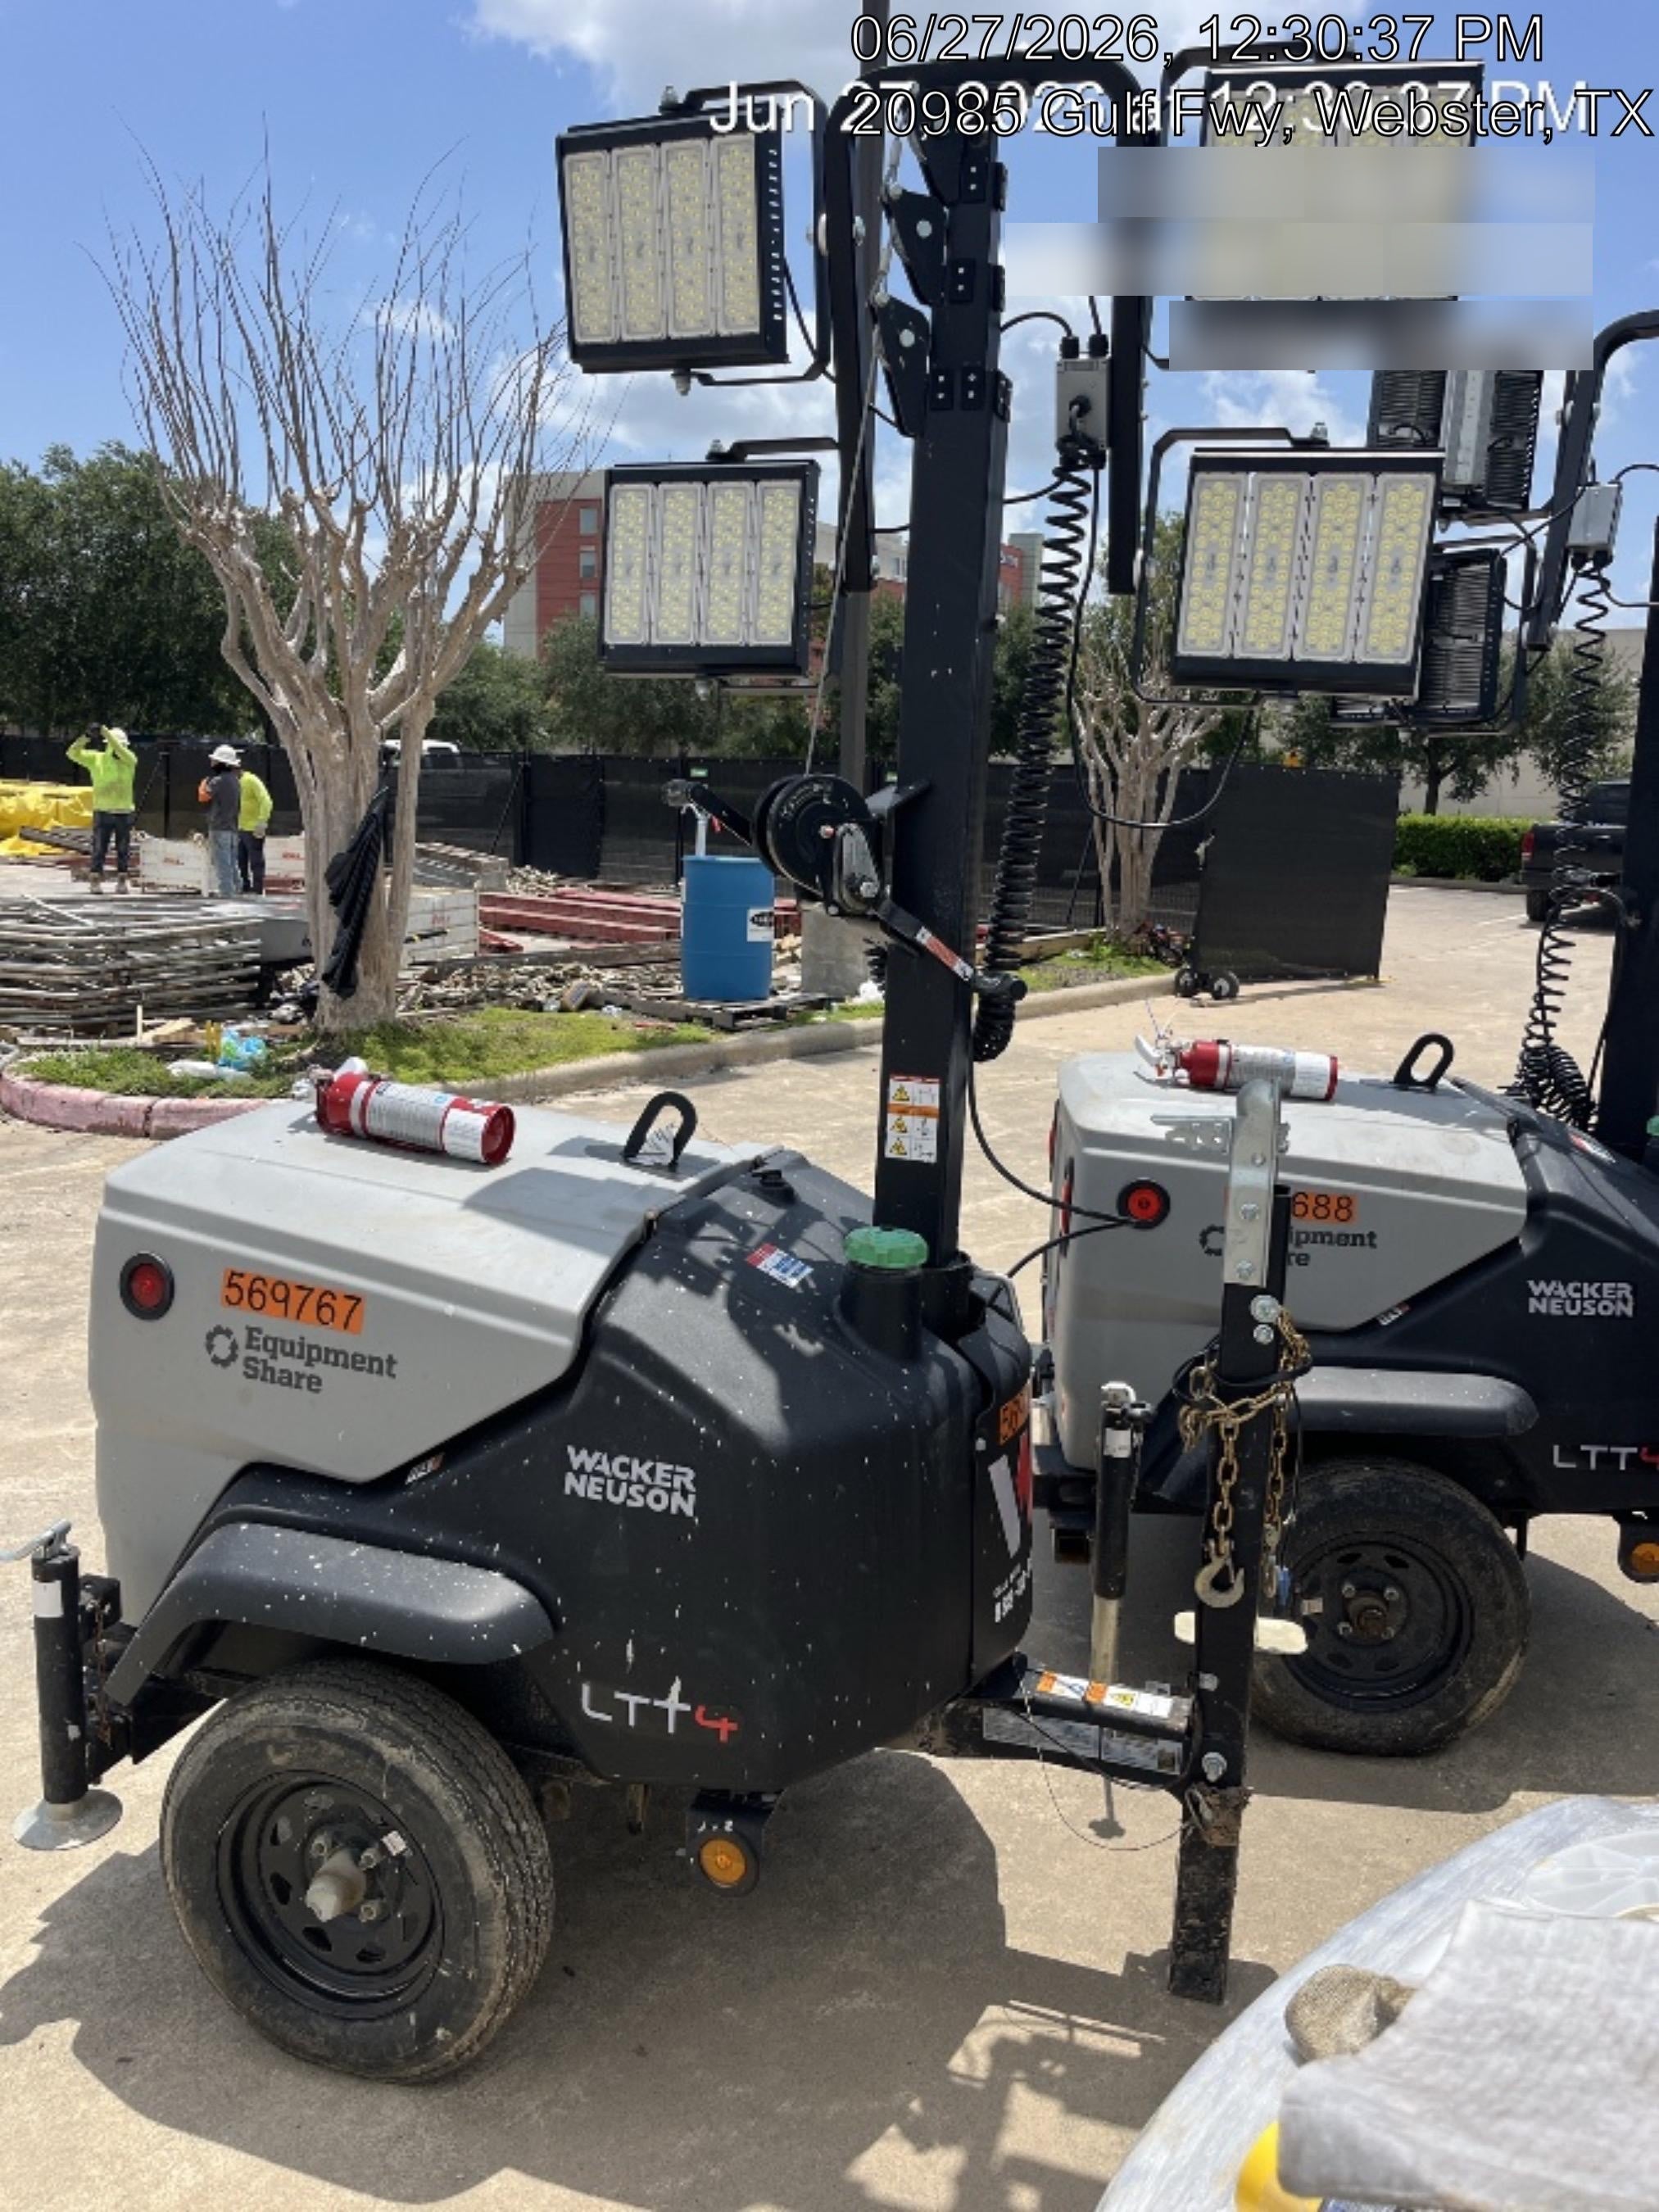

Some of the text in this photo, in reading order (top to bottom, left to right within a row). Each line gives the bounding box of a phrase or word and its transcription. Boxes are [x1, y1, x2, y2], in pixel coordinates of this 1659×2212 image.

[1292, 1192, 1353, 1222] 688
[1288, 1227, 1378, 1249] ipment
[224, 1270, 362, 1331] 569767
[1527, 1280, 1634, 1300] WACKER
[1528, 1297, 1634, 1318] NEUSON
[244, 1324, 398, 1379] Equipment
[243, 1355, 323, 1394] Share
[566, 1444, 697, 1494] WACKER
[564, 1471, 697, 1518] NEUSON
